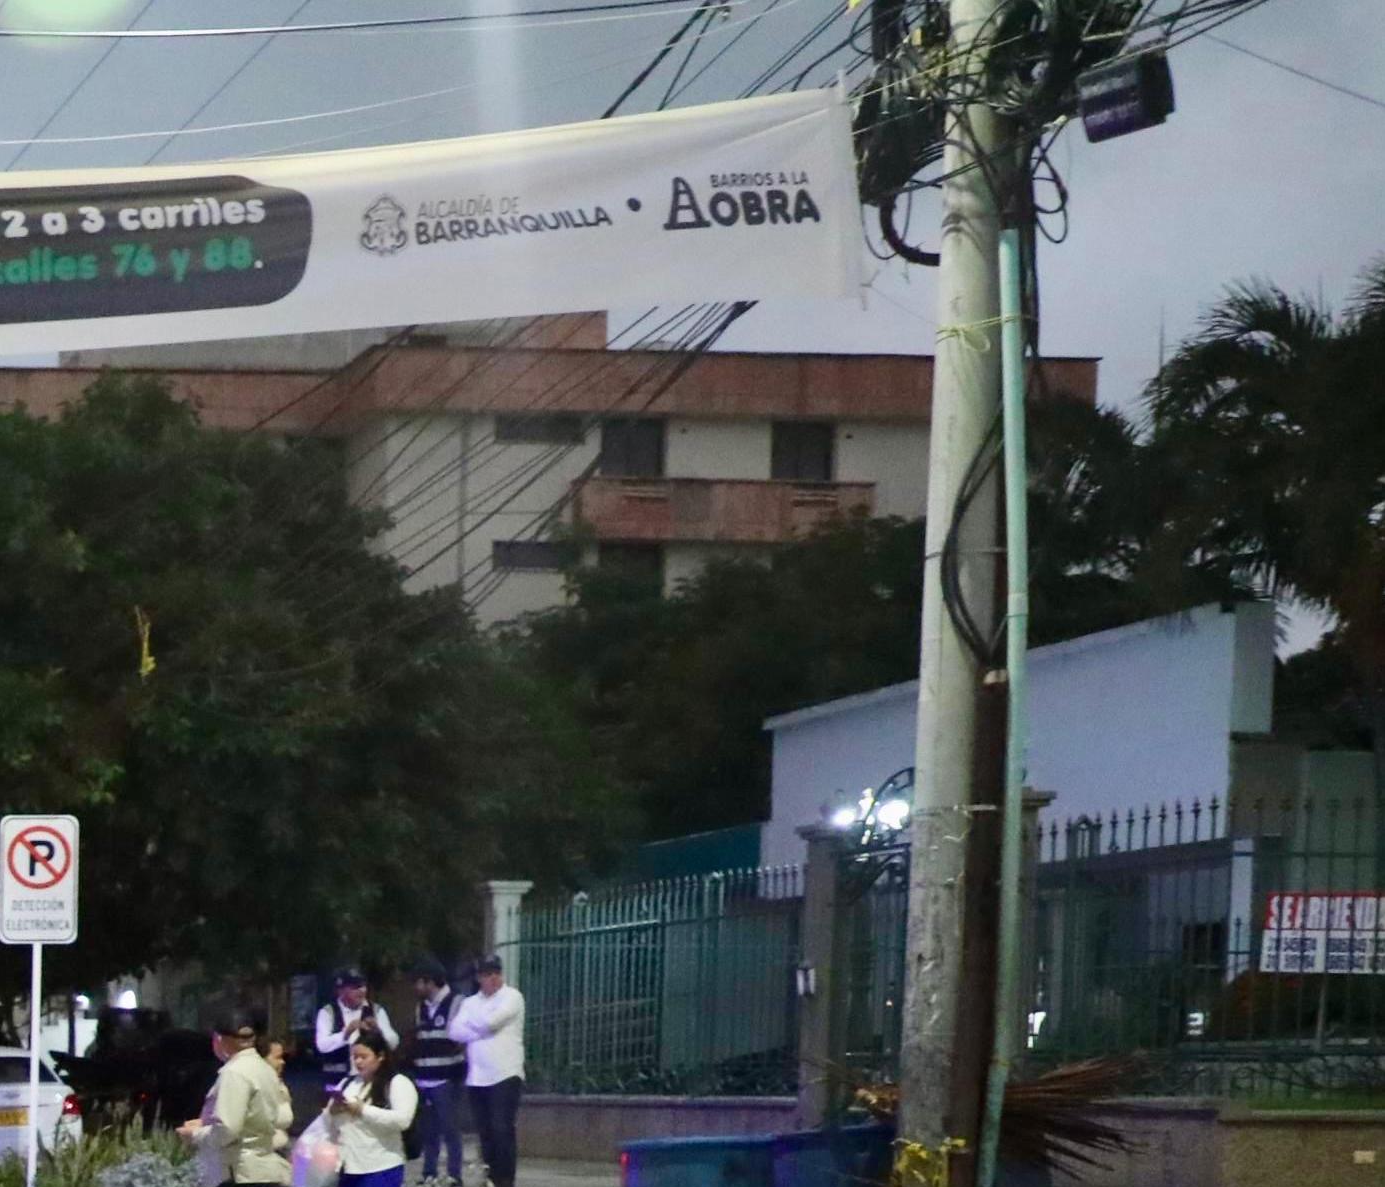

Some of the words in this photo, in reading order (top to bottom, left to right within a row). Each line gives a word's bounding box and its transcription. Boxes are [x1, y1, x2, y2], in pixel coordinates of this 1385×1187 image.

[710, 172, 774, 188] BARRIOS
[778, 171, 788, 184] A
[792, 171, 809, 185] LA
[0, 210, 29, 238] 2
[41, 212, 68, 235] a
[78, 206, 106, 233] 3
[118, 197, 267, 231] carriles
[415, 206, 613, 245] BARRANQUILLA
[417, 193, 493, 219] ALCALDÍA
[498, 197, 520, 215] DE
[111, 243, 157, 277] 76
[170, 249, 190, 282] y
